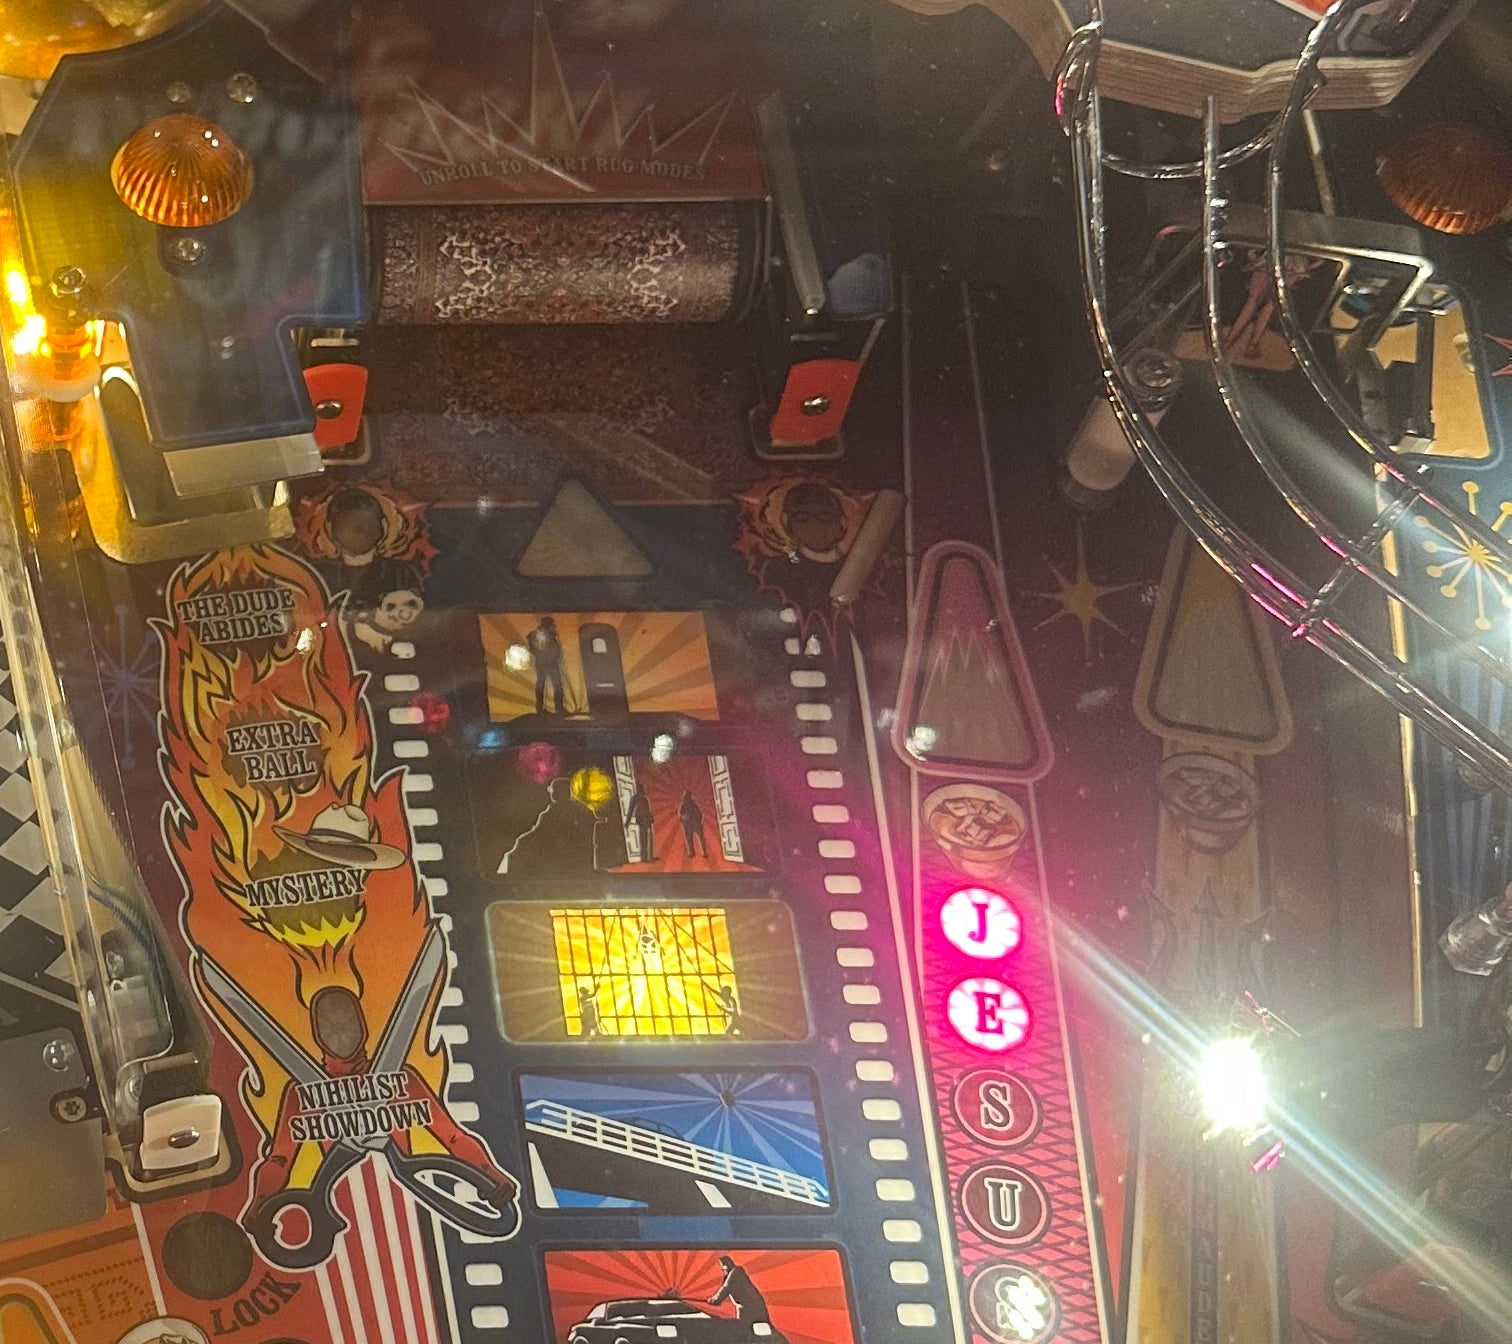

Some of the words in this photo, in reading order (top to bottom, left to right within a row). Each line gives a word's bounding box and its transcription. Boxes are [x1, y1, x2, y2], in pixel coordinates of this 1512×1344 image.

[418, 159, 497, 187] UNROLL
[499, 158, 522, 175] TO
[527, 157, 589, 175] START
[597, 157, 635, 174] RUG
[641, 159, 707, 182] MODES
[175, 596, 228, 624] THE
[230, 586, 296, 618] DUDE
[195, 611, 287, 647] ABIDES
[224, 717, 321, 757] EXTRA
[243, 748, 318, 785] BALL
[245, 867, 366, 910] MYSTERY
[296, 1071, 410, 1113] NIHILIST
[289, 1098, 434, 1143] SHOWDOWN
[210, 1270, 302, 1340] LOCK
